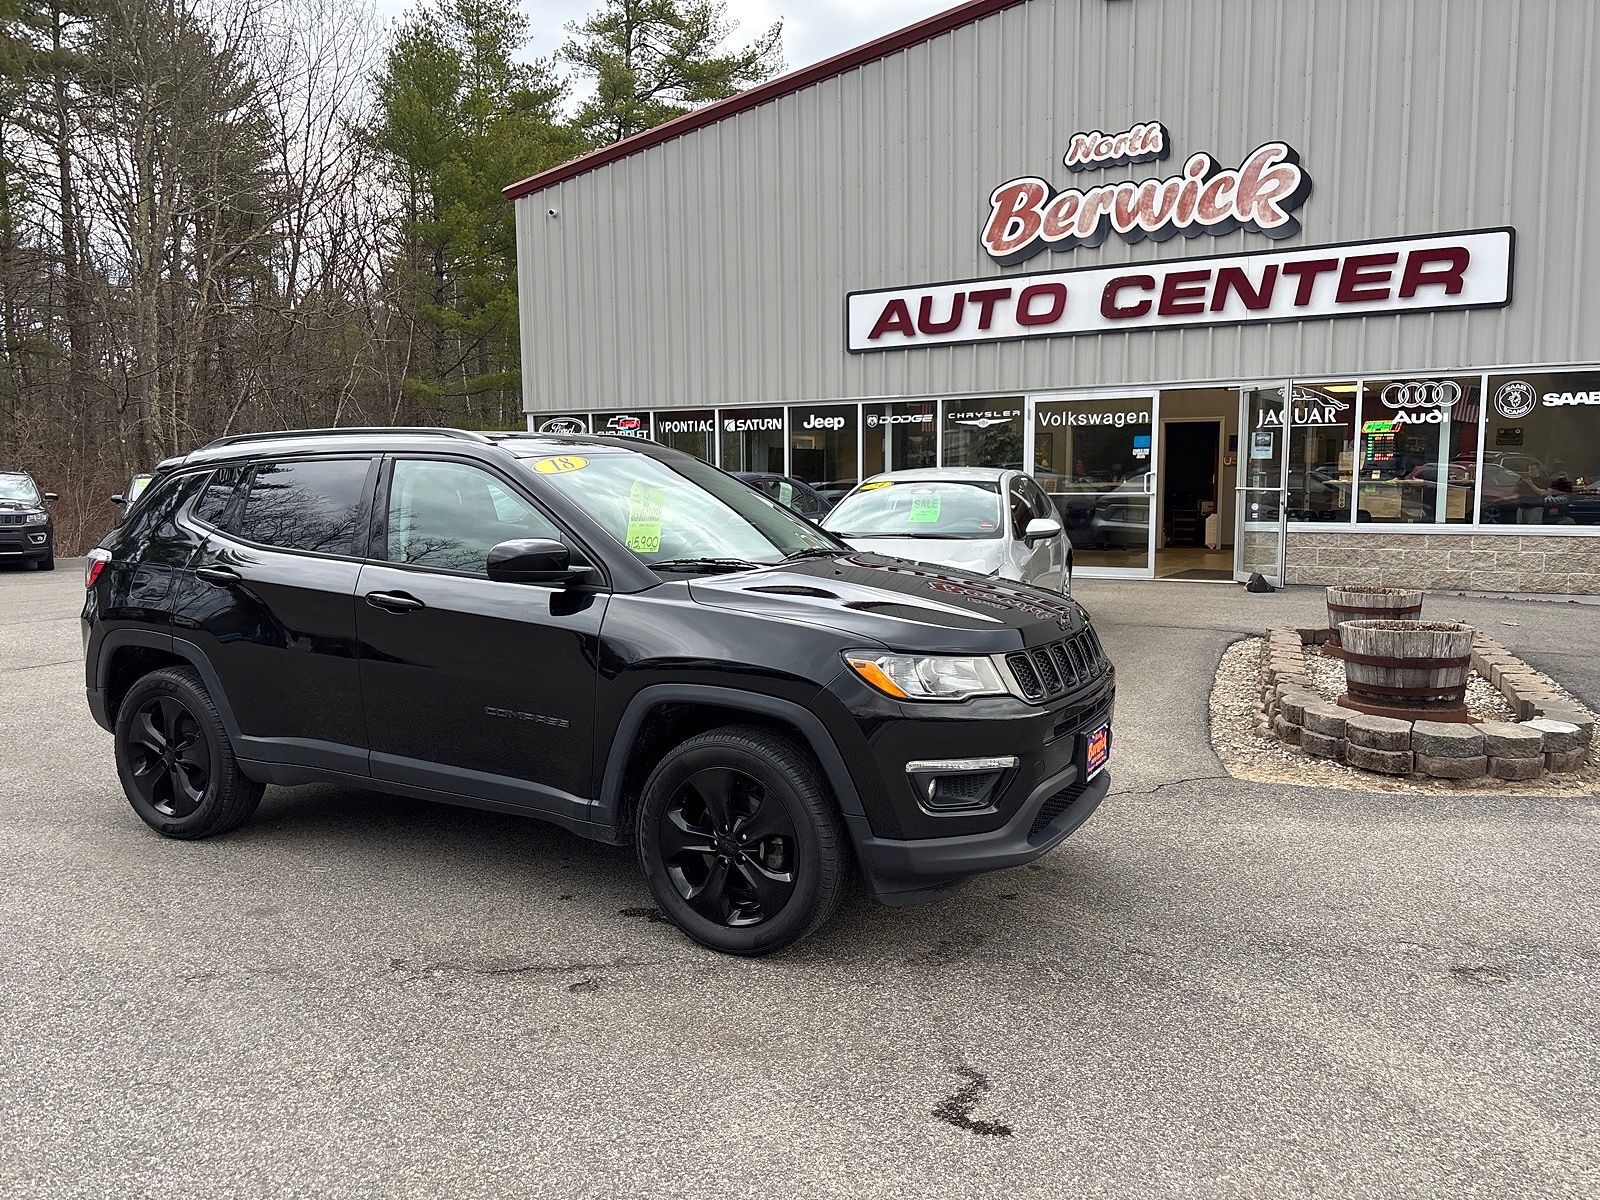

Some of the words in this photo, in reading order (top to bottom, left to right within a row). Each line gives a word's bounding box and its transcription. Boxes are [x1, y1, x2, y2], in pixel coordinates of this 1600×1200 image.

[1066, 124, 1161, 164] North
[983, 143, 1298, 254] Berwick
[867, 283, 1068, 340] AUTO
[1100, 246, 1471, 320] CENTER
[1542, 392, 1600, 407] SAAB
[879, 414, 933, 424] DODGE
[948, 410, 1021, 419] CHRYSLER
[1038, 411, 1149, 428] Volkswagen
[1391, 409, 1449, 424] Audi
[549, 422, 575, 433] Ford
[737, 418, 782, 431] SATURN
[803, 414, 845, 431] Jeep
[550, 457, 574, 472] 18
[914, 499, 938, 508] SALE
[484, 705, 570, 728] COMPASS
